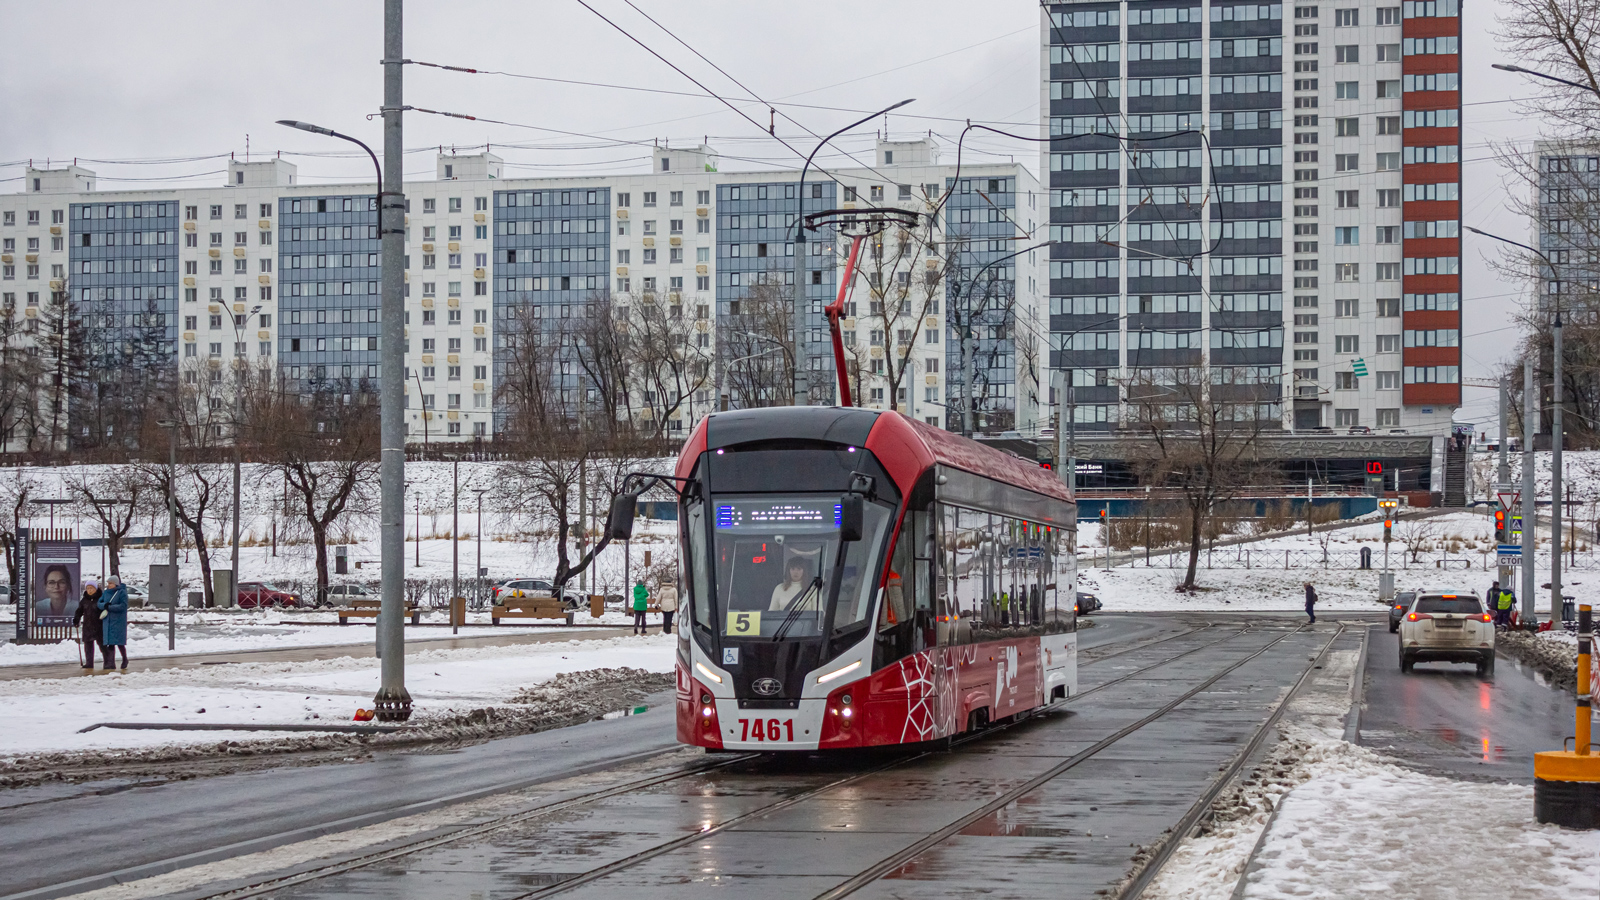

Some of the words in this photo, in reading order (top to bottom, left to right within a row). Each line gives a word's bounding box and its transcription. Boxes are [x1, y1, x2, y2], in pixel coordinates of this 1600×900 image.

[1500, 557, 1523, 565] СТОП
[18, 610, 26, 631] МУЗЕЙ
[735, 614, 750, 632] 5
[738, 718, 794, 742] 7461
